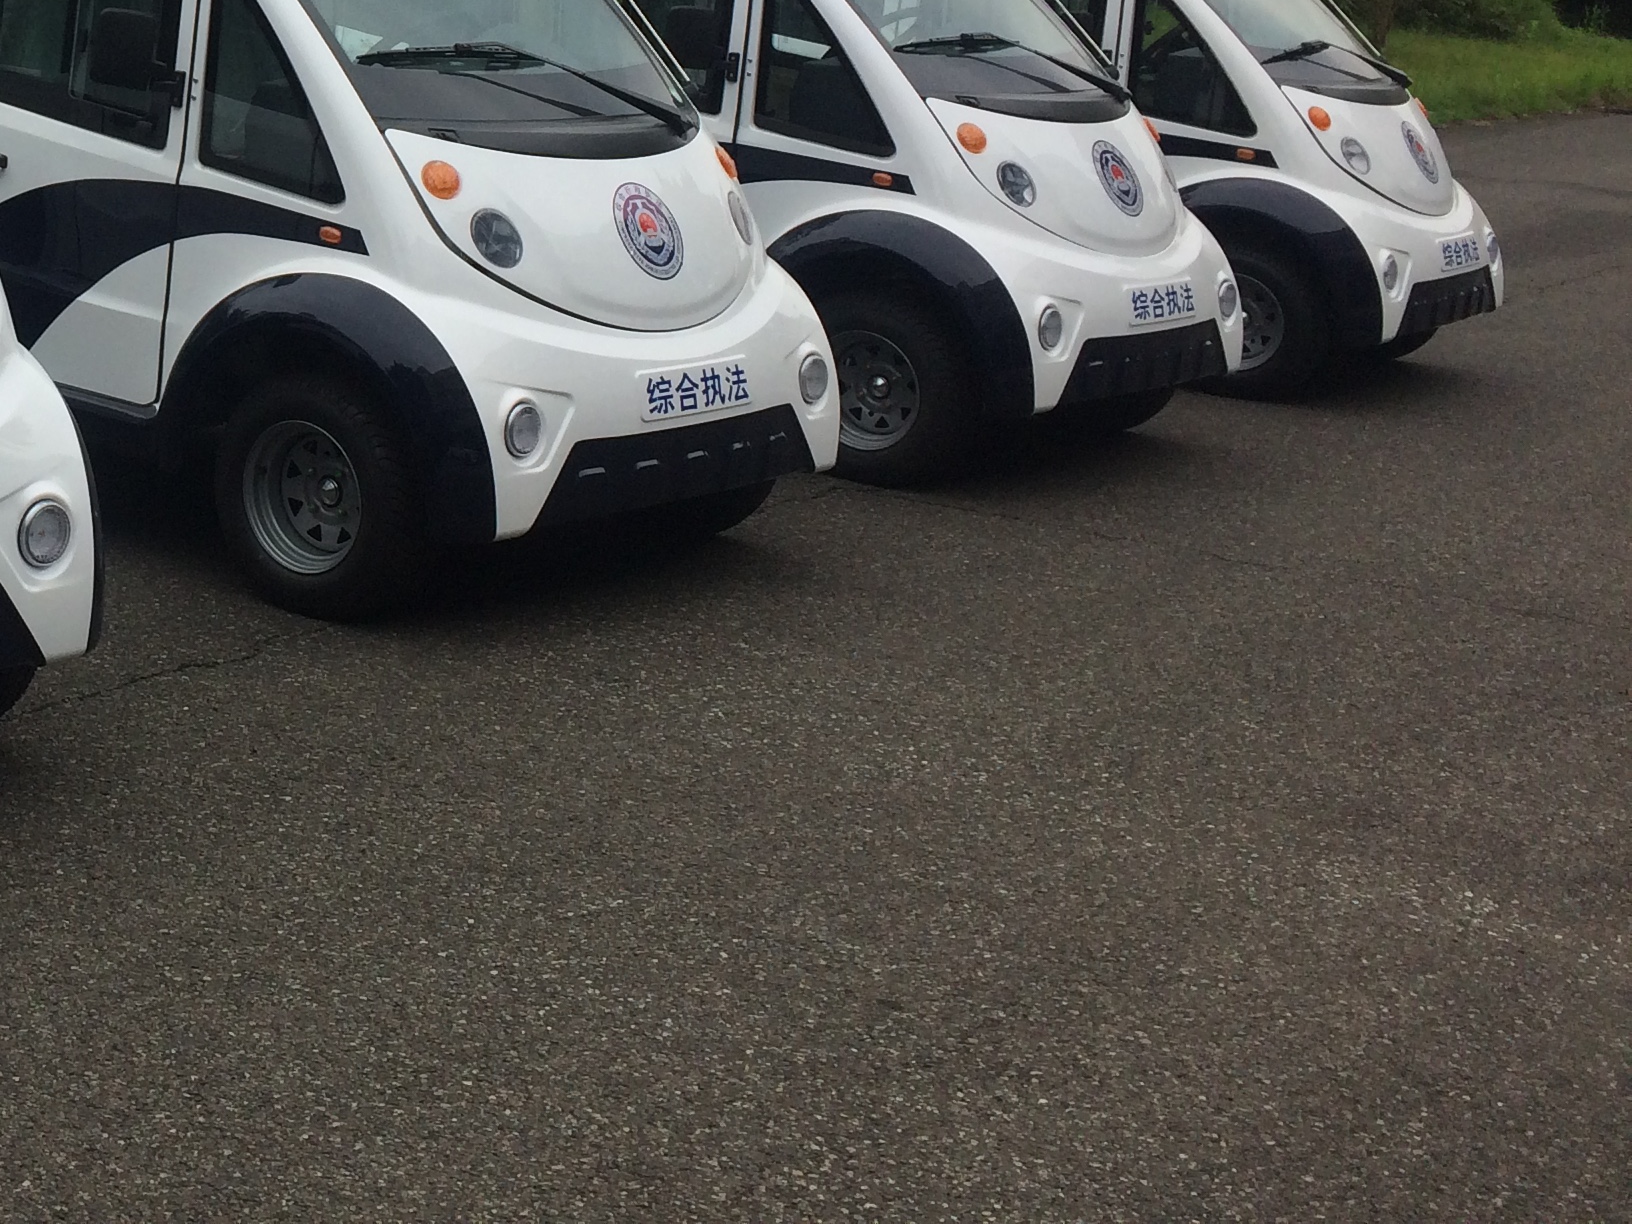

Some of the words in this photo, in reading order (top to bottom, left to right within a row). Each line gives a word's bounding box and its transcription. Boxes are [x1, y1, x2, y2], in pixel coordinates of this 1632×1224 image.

[1132, 283, 1195, 320] 综合执法
[646, 364, 750, 414] 综合执法
